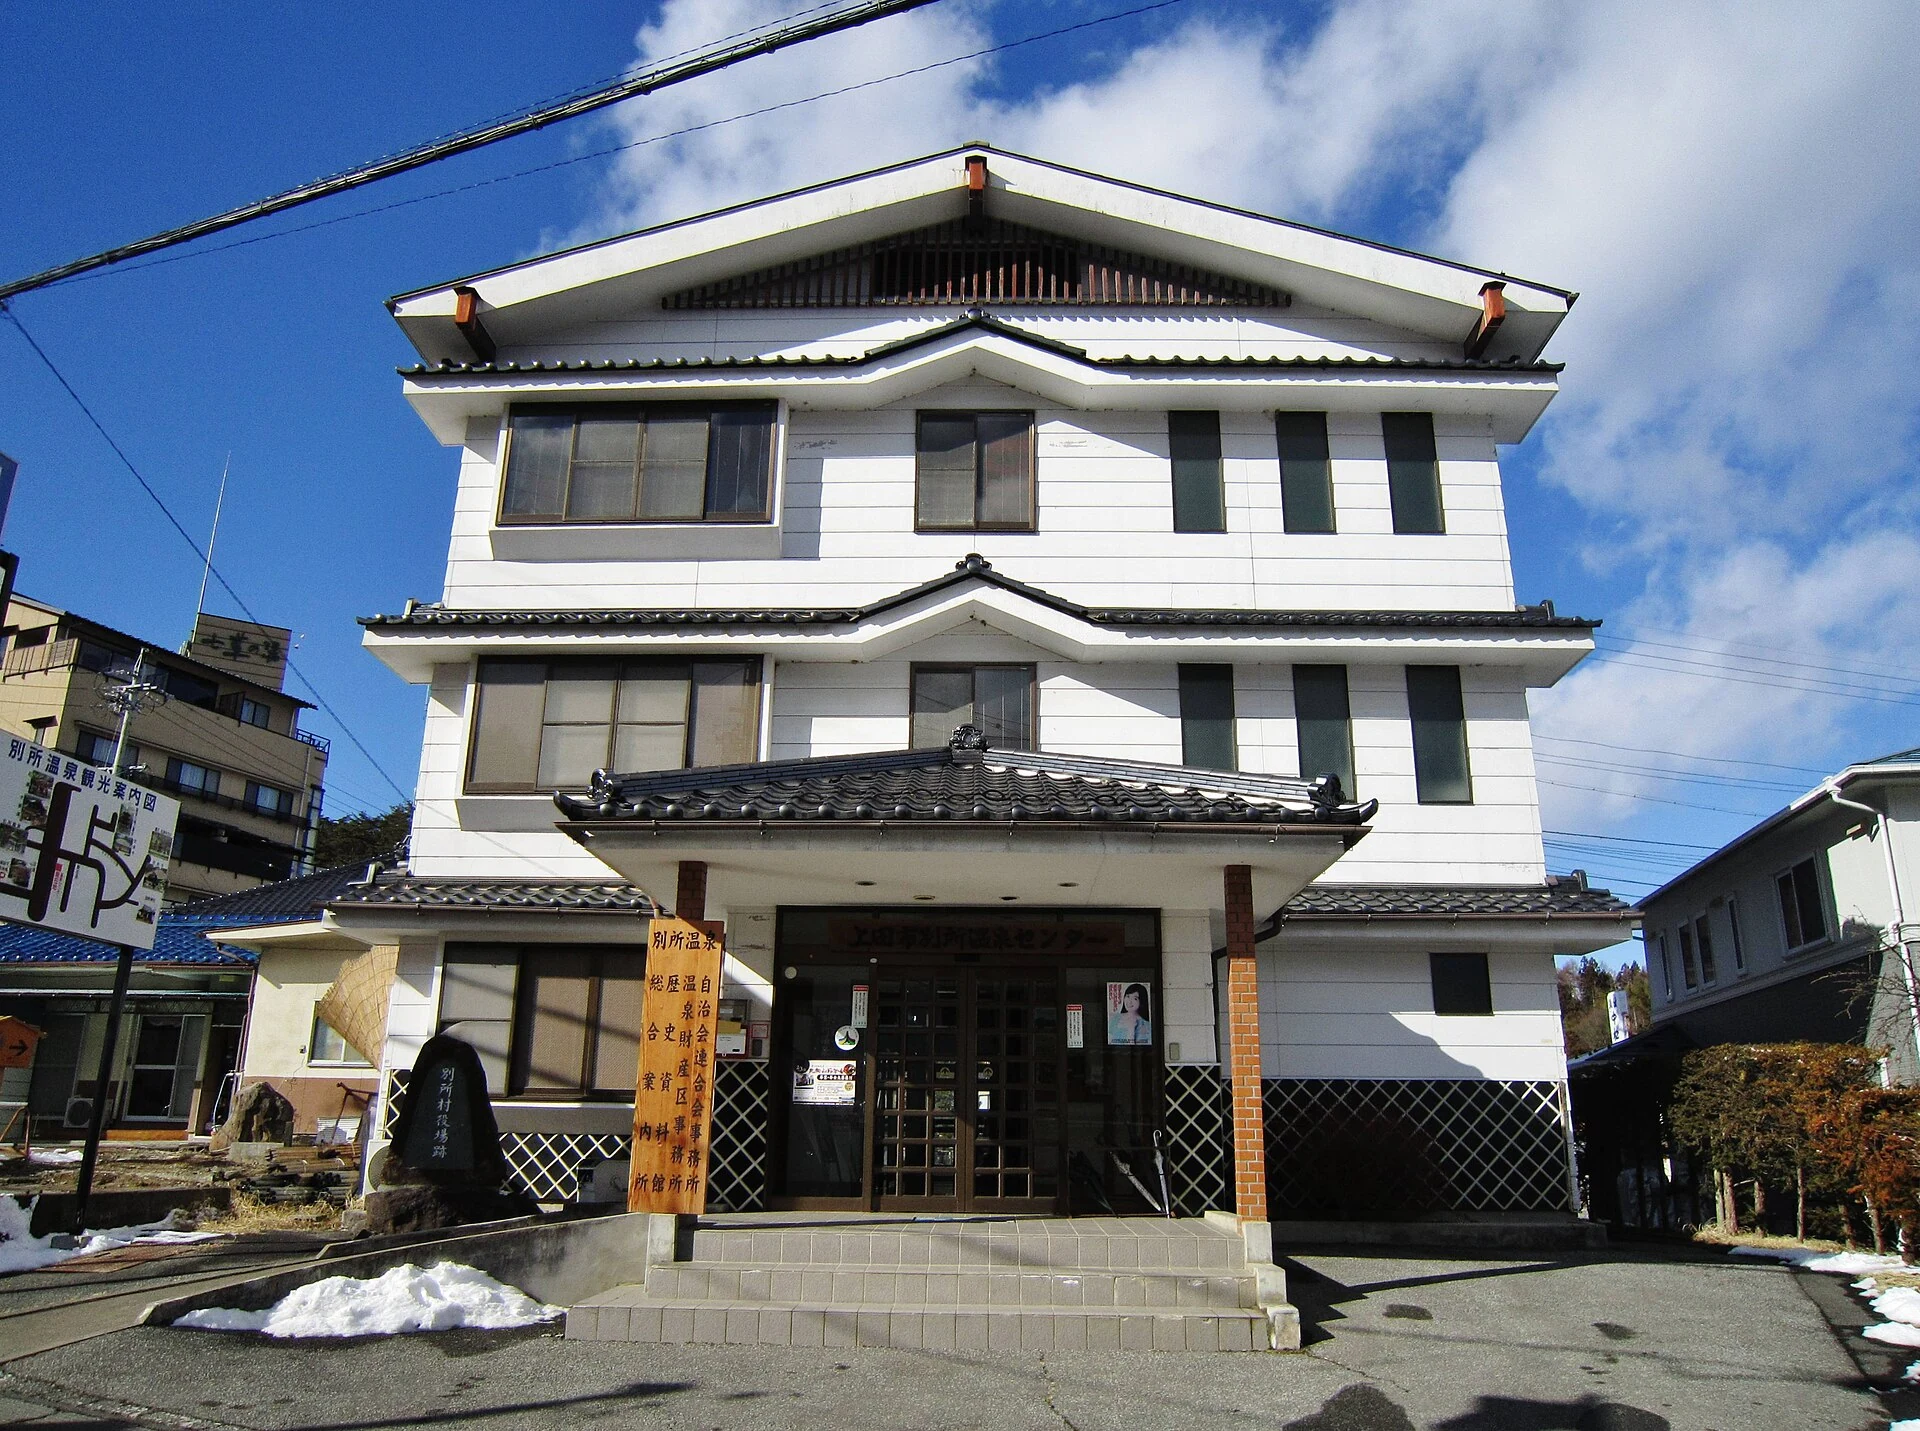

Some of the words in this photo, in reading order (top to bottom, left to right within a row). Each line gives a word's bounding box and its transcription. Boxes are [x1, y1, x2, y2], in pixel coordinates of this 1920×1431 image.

[8, 739, 157, 813] 別所温泉観光案内図
[652, 930, 718, 951] 別所温泉
[431, 1067, 455, 1159] 別所村役場跡
[634, 974, 665, 1193] 総合案内所
[651, 974, 680, 1193] 歴史資料館
[668, 975, 697, 1194] 温泉財産区事務所
[684, 975, 711, 1195] 自治会連合会事務所
